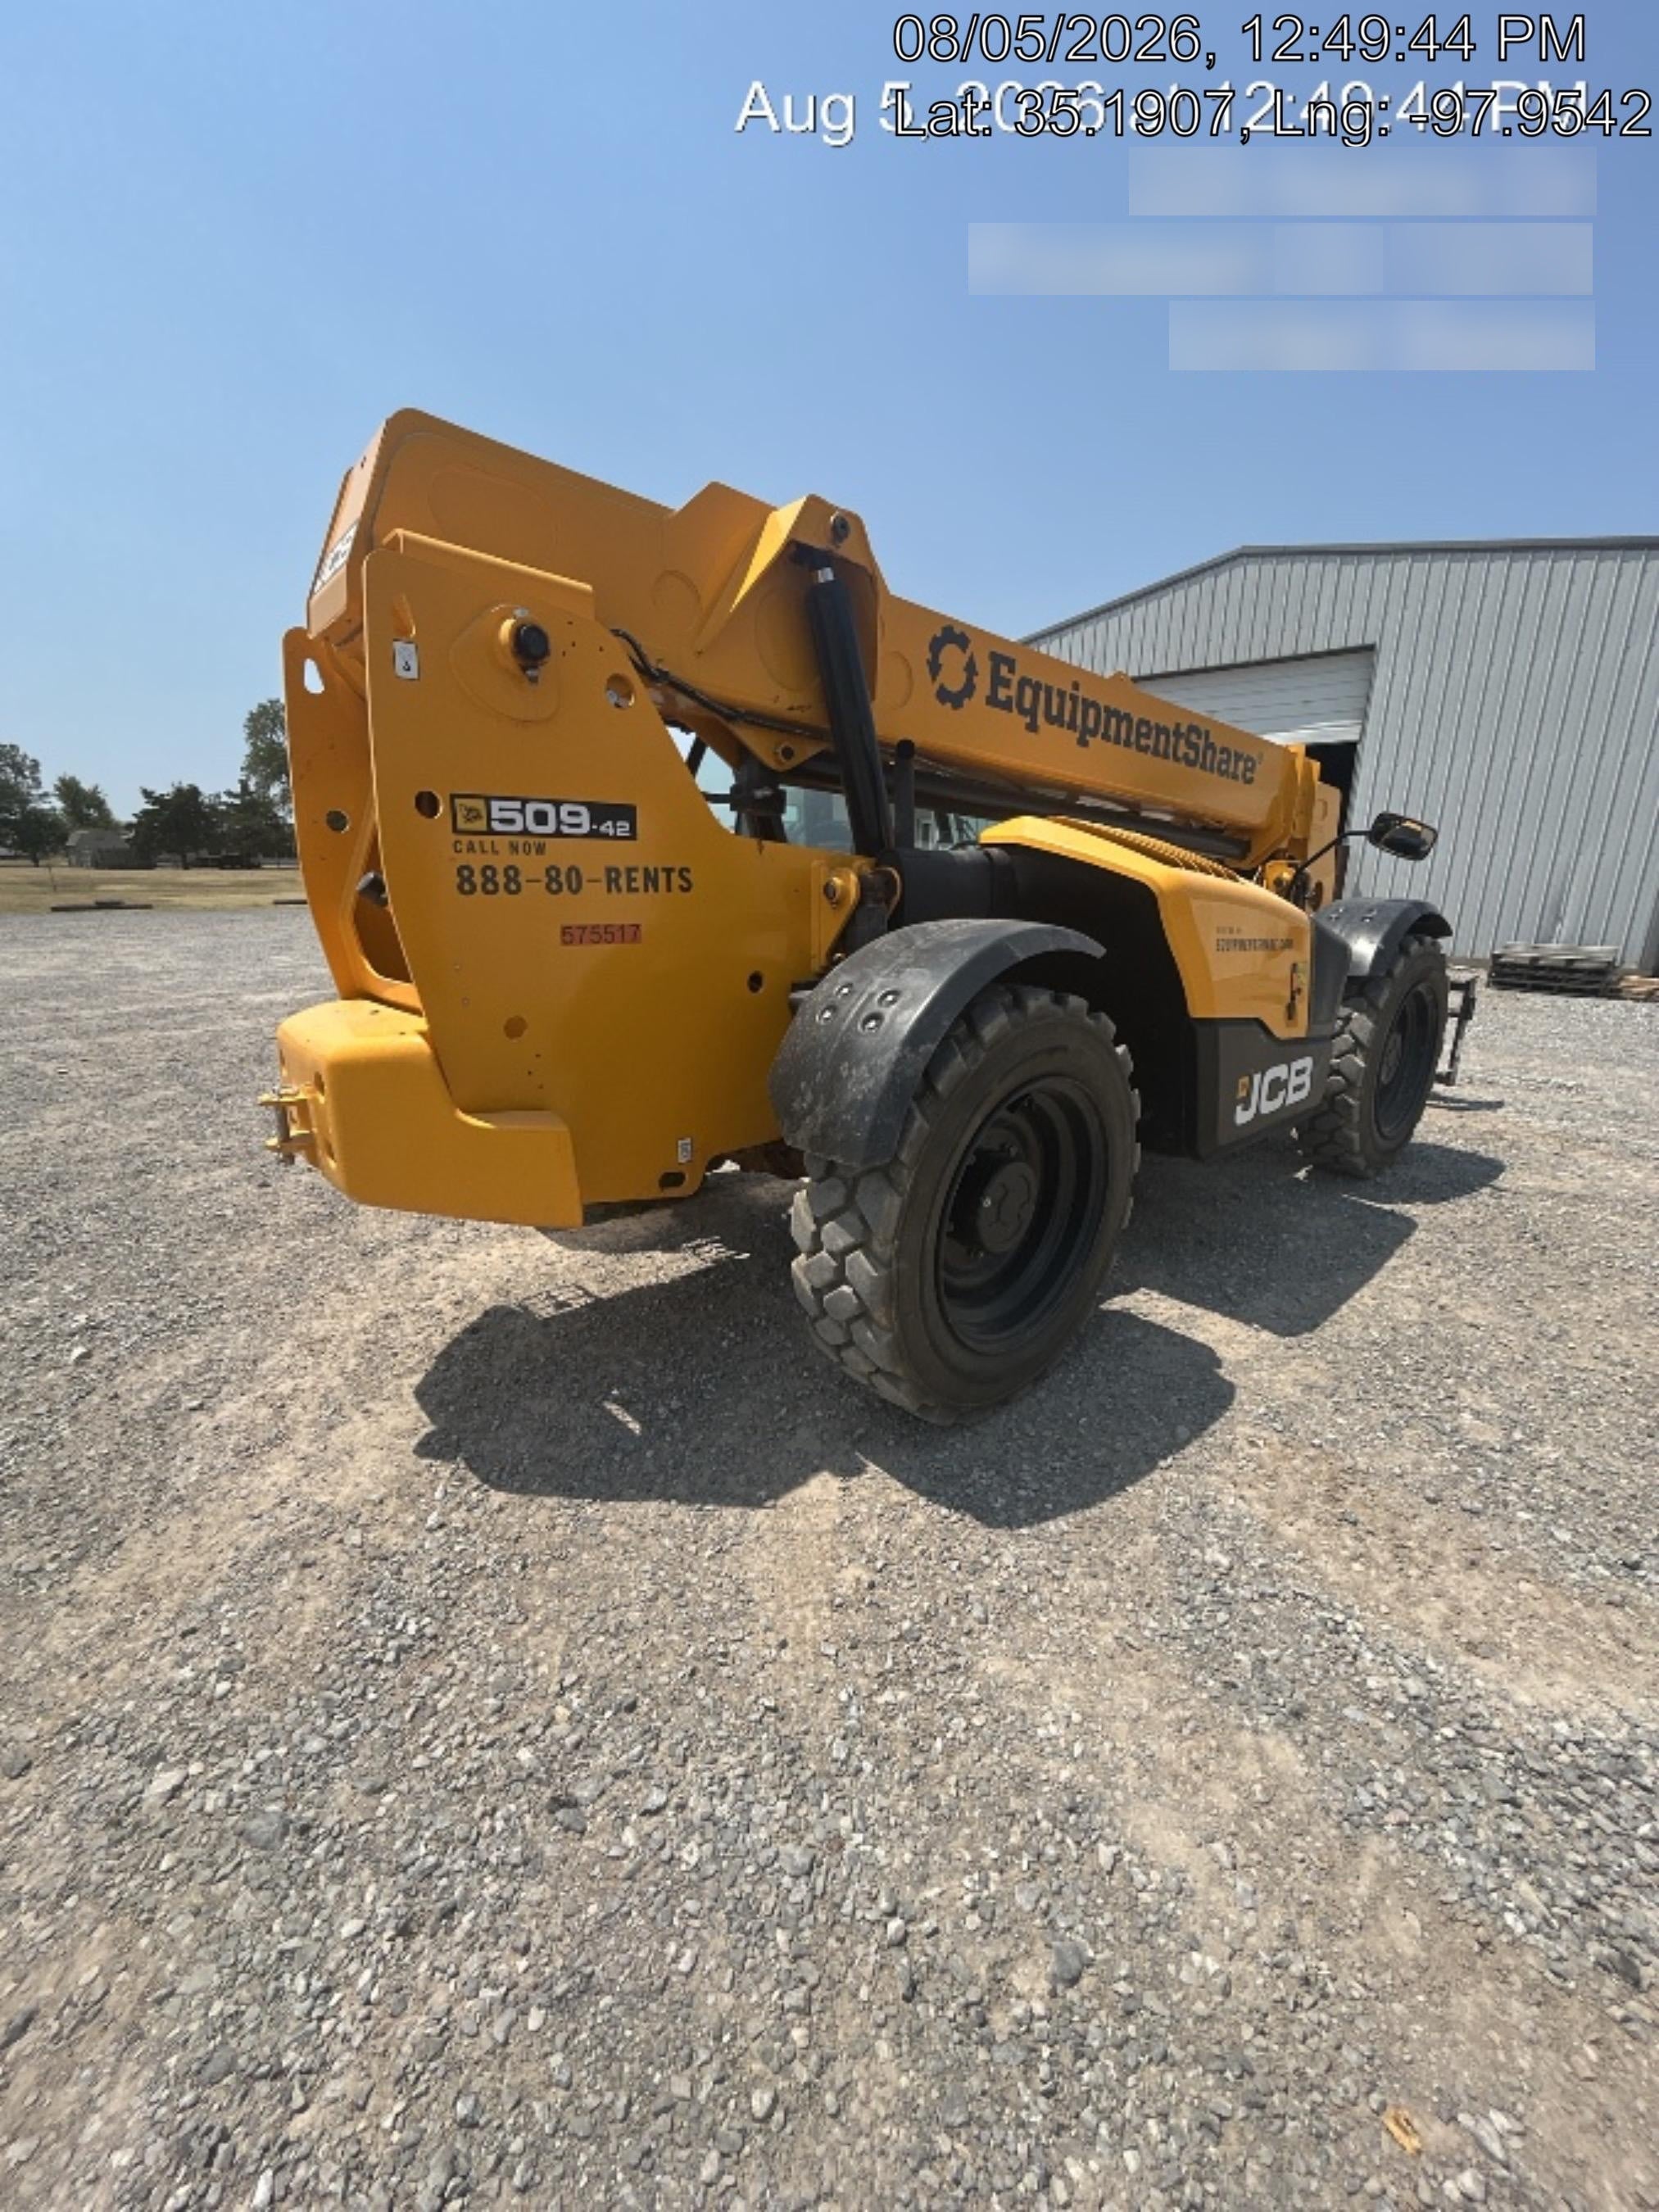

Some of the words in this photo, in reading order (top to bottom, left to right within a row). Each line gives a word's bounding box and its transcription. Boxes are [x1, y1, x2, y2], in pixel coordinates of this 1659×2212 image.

[985, 650, 1257, 785] EquipmentShare
[453, 840, 500, 854] CALL
[509, 841, 546, 856] NOW
[456, 864, 693, 895] 888-80-RENTS
[1235, 1056, 1313, 1126] JCB
